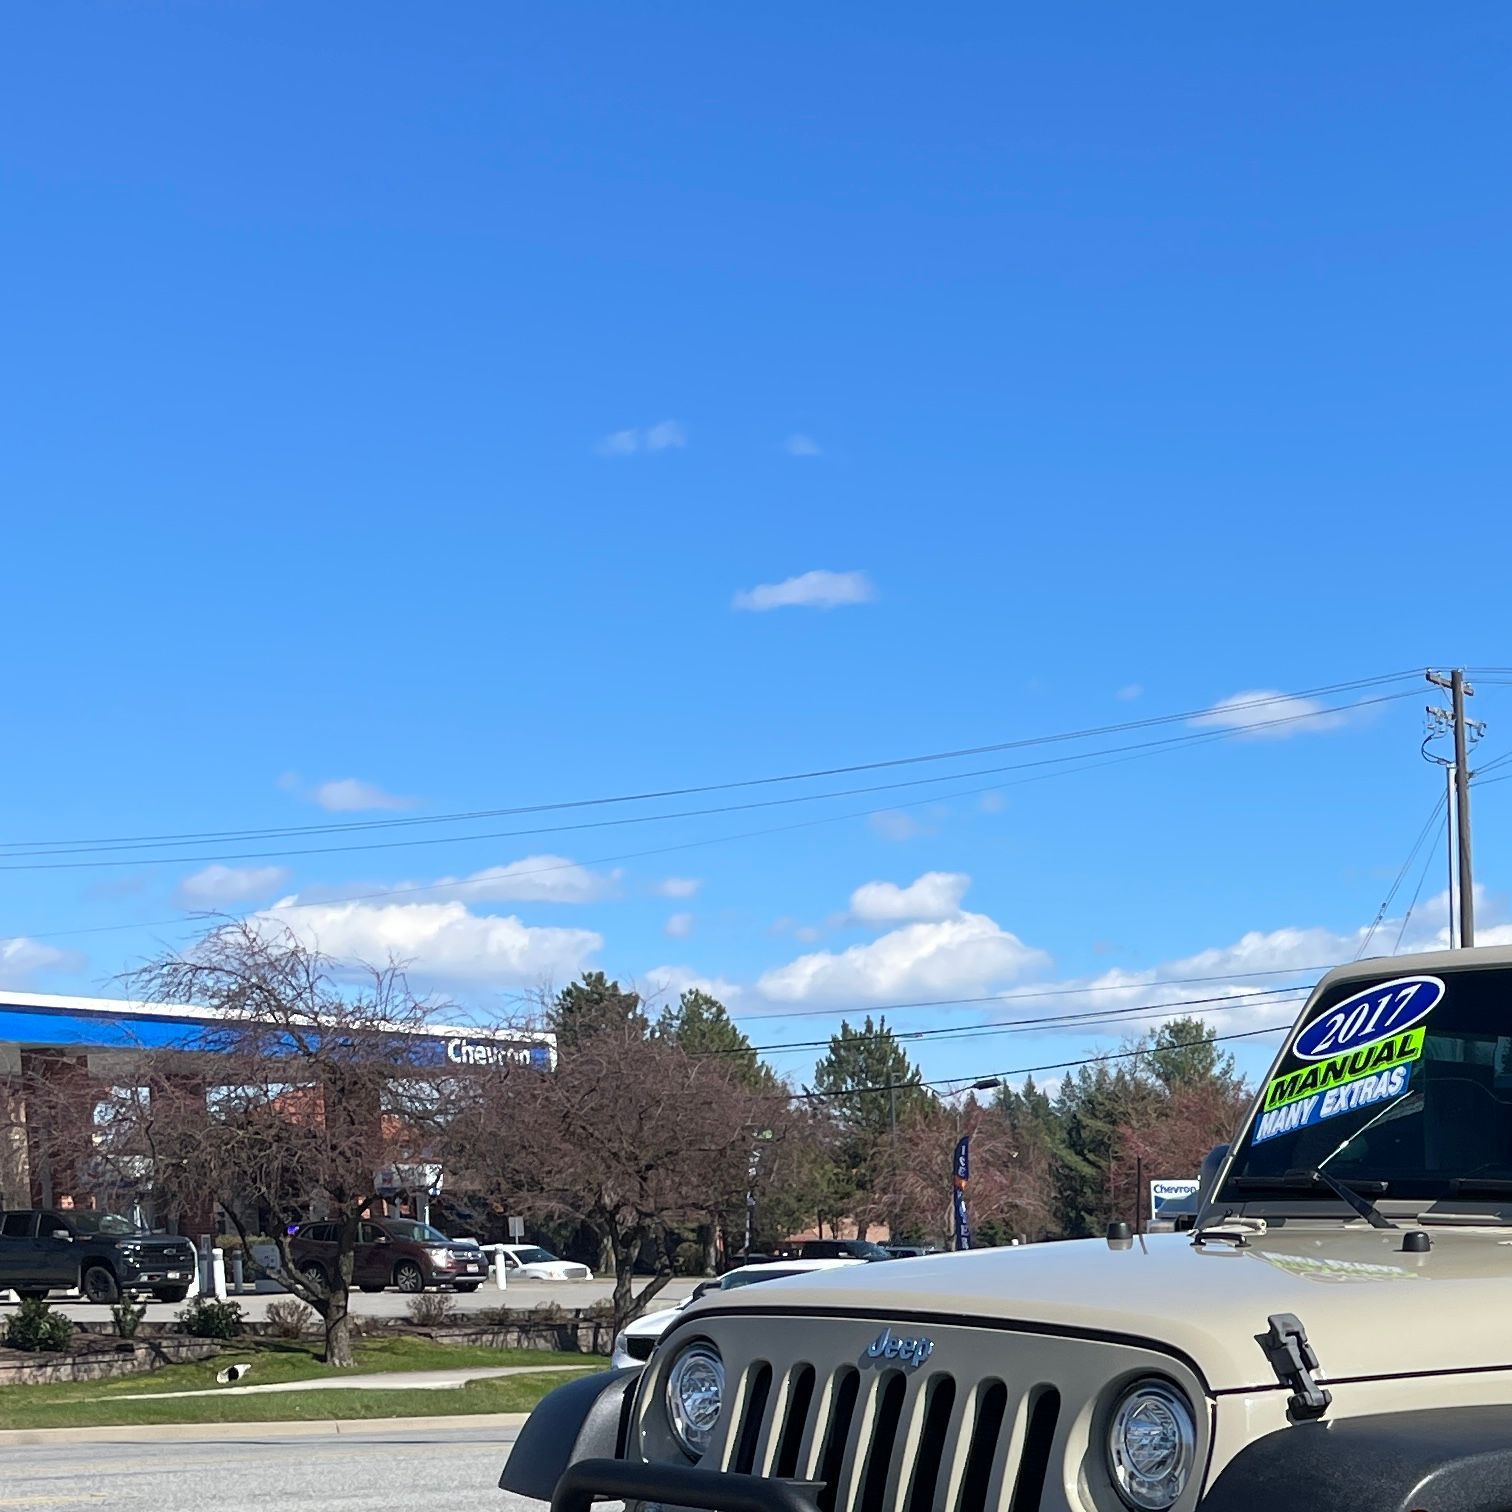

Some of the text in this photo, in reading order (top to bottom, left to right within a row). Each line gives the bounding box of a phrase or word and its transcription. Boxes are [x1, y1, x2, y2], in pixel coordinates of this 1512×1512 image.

[1310, 983, 1422, 1055] 2017
[1255, 1066, 1406, 1141] MANY EXTRAS
[1268, 1033, 1418, 1106] MANUAL
[1153, 1183, 1197, 1194] Chevron
[868, 1327, 934, 1367] Jeep
